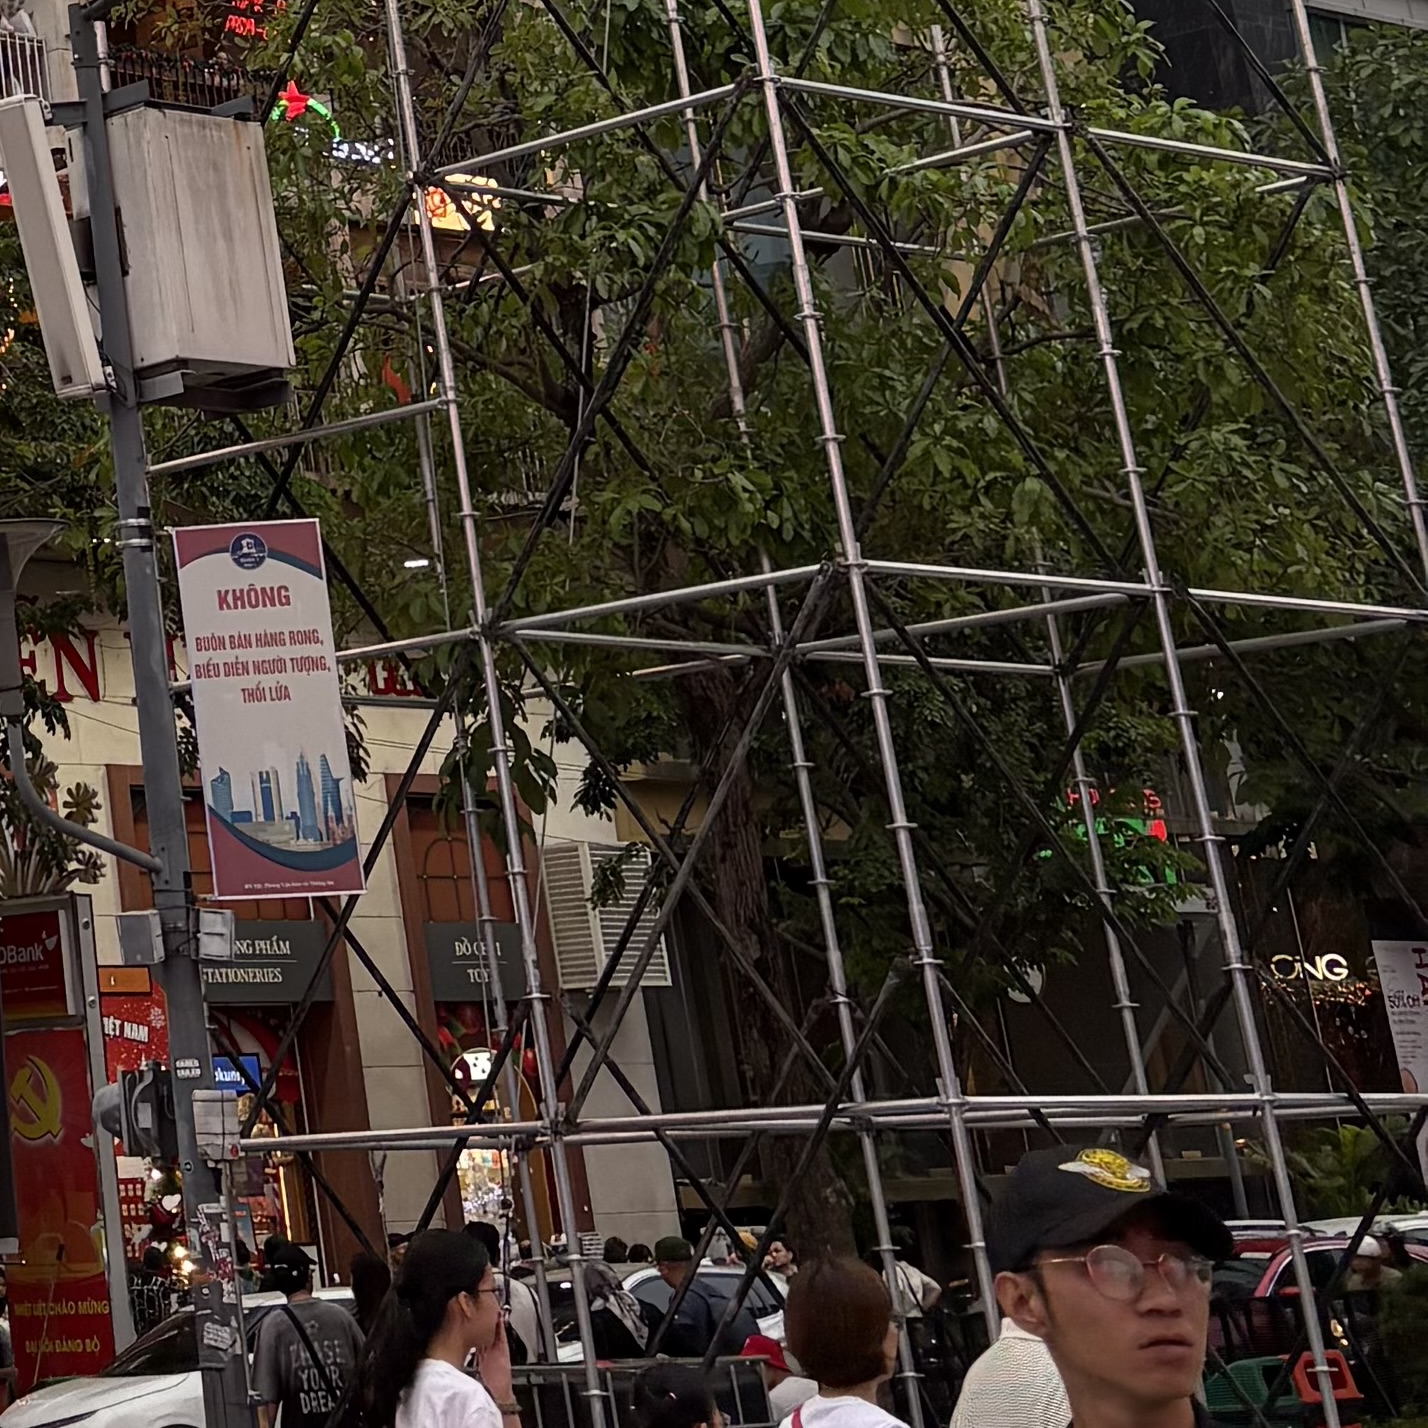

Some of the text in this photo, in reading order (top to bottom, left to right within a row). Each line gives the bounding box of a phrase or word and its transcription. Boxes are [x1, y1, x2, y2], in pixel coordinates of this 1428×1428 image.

[216, 583, 292, 612] KHÔNG
[228, 630, 253, 652] BÁN
[202, 966, 284, 985] TATIONERIES
[123, 1021, 150, 1044] NAM
